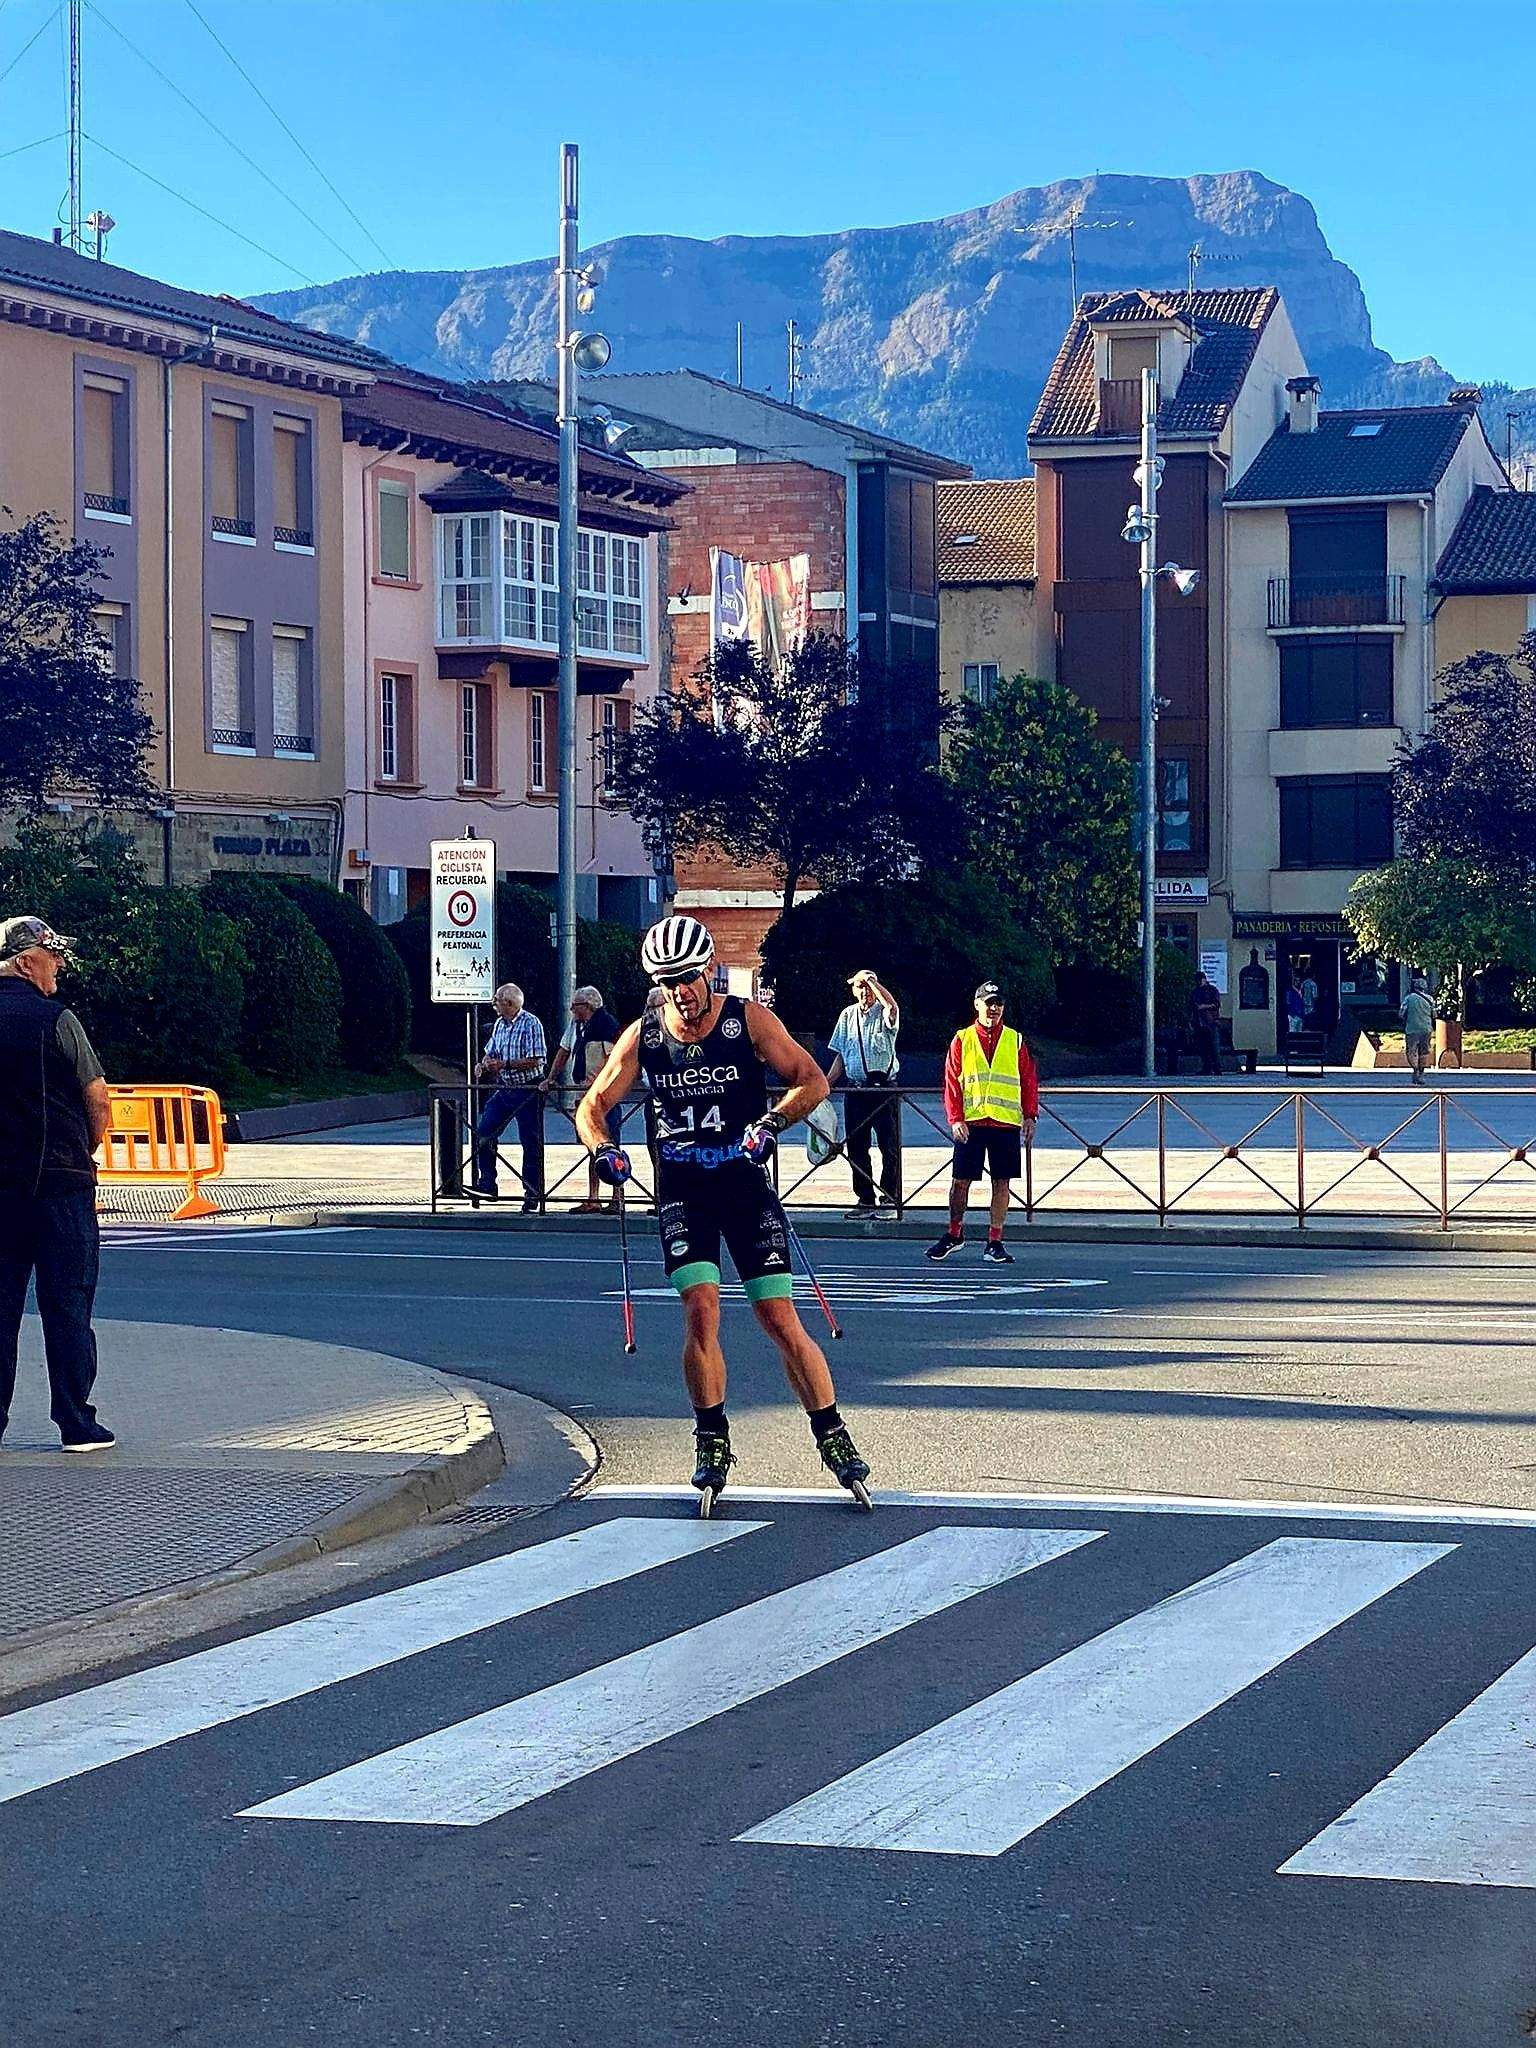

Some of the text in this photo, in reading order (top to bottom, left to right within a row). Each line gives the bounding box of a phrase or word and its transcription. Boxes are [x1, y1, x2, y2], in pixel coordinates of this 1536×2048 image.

[437, 848, 486, 860] ATENCIÓN
[440, 863, 483, 873] CICLISTA
[436, 876, 487, 885] RECUERDA
[1154, 882, 1193, 894] LIDA
[456, 902, 469, 914] 10
[1236, 921, 1292, 933] PANADERIA
[437, 930, 487, 939] PREFERENCIA
[442, 941, 482, 950] PEATONAL
[680, 1105, 726, 1132] 14
